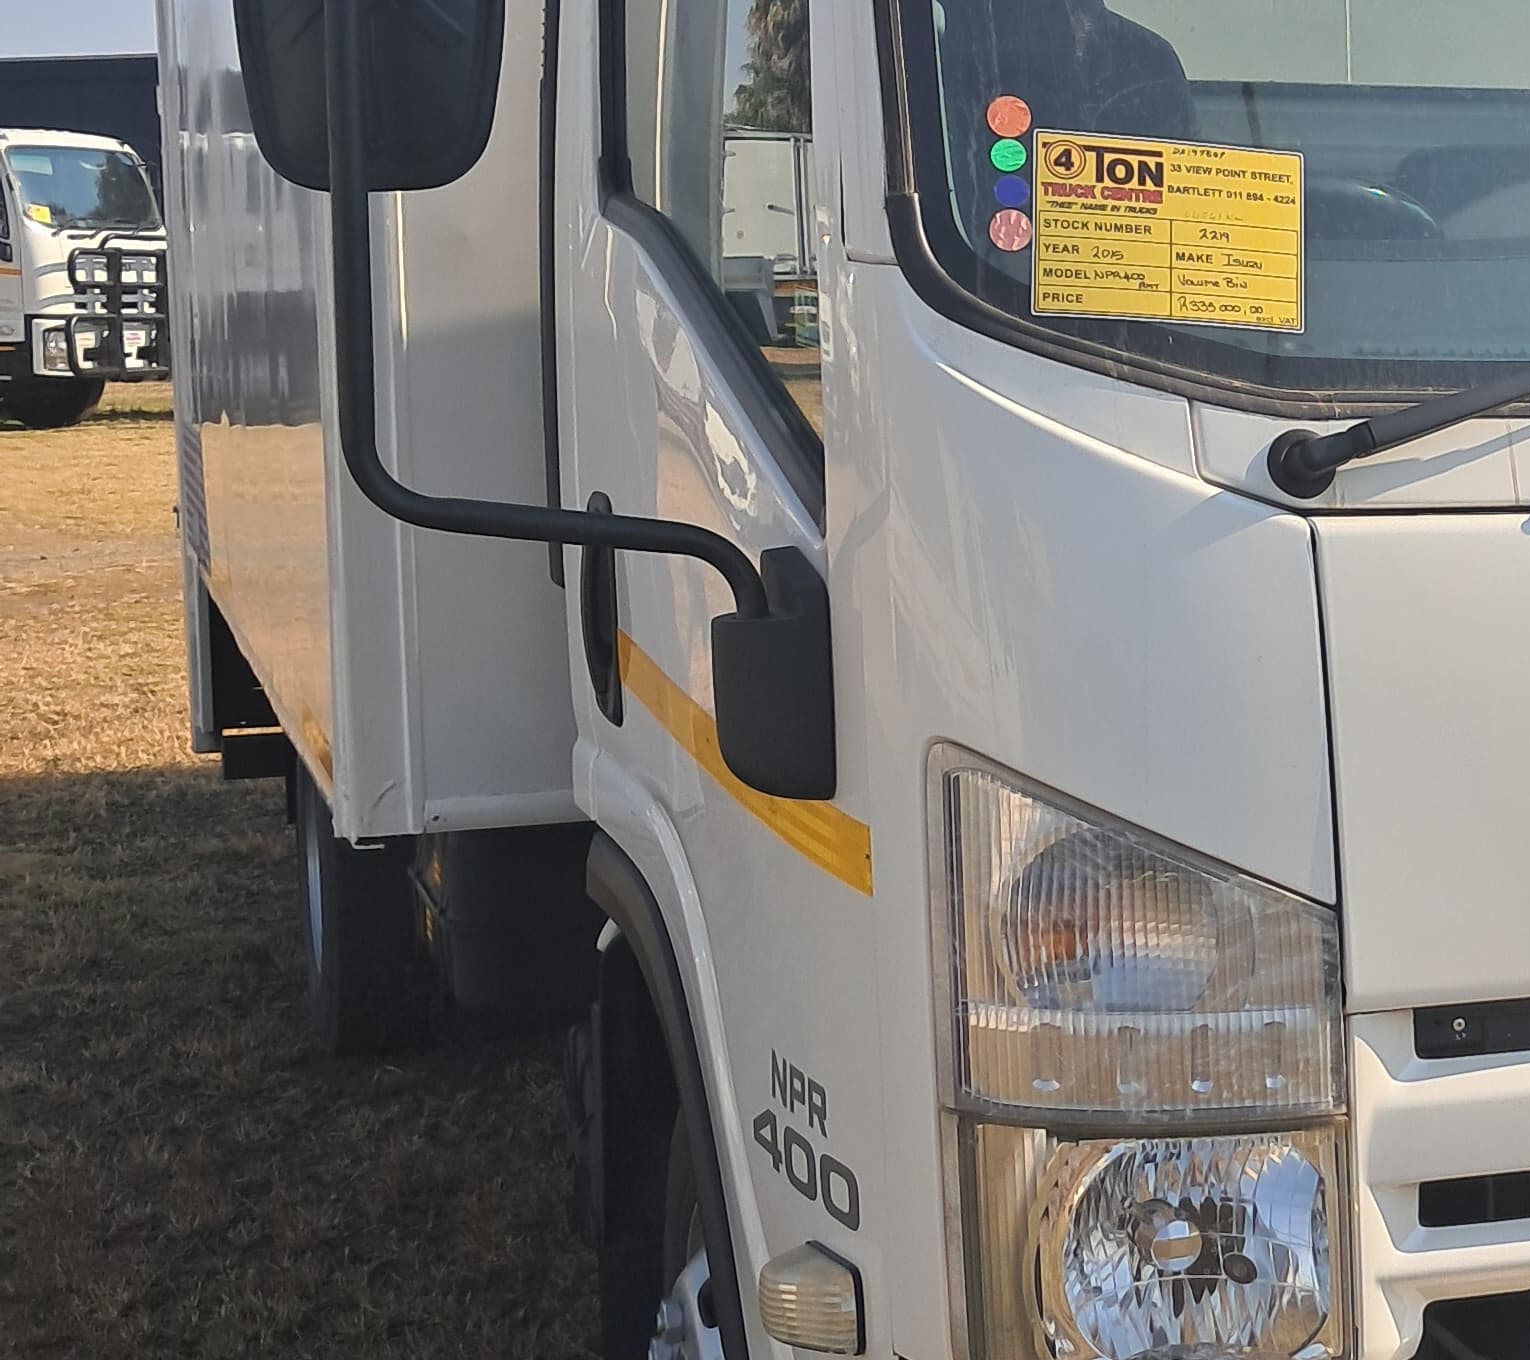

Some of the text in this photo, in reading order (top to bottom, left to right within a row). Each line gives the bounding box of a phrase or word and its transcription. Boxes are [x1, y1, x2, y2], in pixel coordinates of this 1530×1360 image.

[1053, 144, 1164, 189] 4 TON
[1184, 164, 1212, 177] VIEW
[1215, 167, 1249, 180] POINT
[1041, 182, 1164, 205] TRUCK CENTRE
[1167, 184, 1224, 199] BARTLETT
[1226, 190, 1244, 200] 011
[1110, 204, 1122, 213] IN
[1124, 205, 1158, 216] TRUCKS
[1043, 218, 1153, 236] STOCK NUMBER
[1042, 242, 1125, 261] YEAR 2015
[1175, 251, 1214, 265] MAKE
[1042, 267, 1091, 280] MODEL
[1042, 291, 1084, 304] PRICE
[770, 1046, 829, 1140] NPR
[752, 1107, 862, 1233] 400
